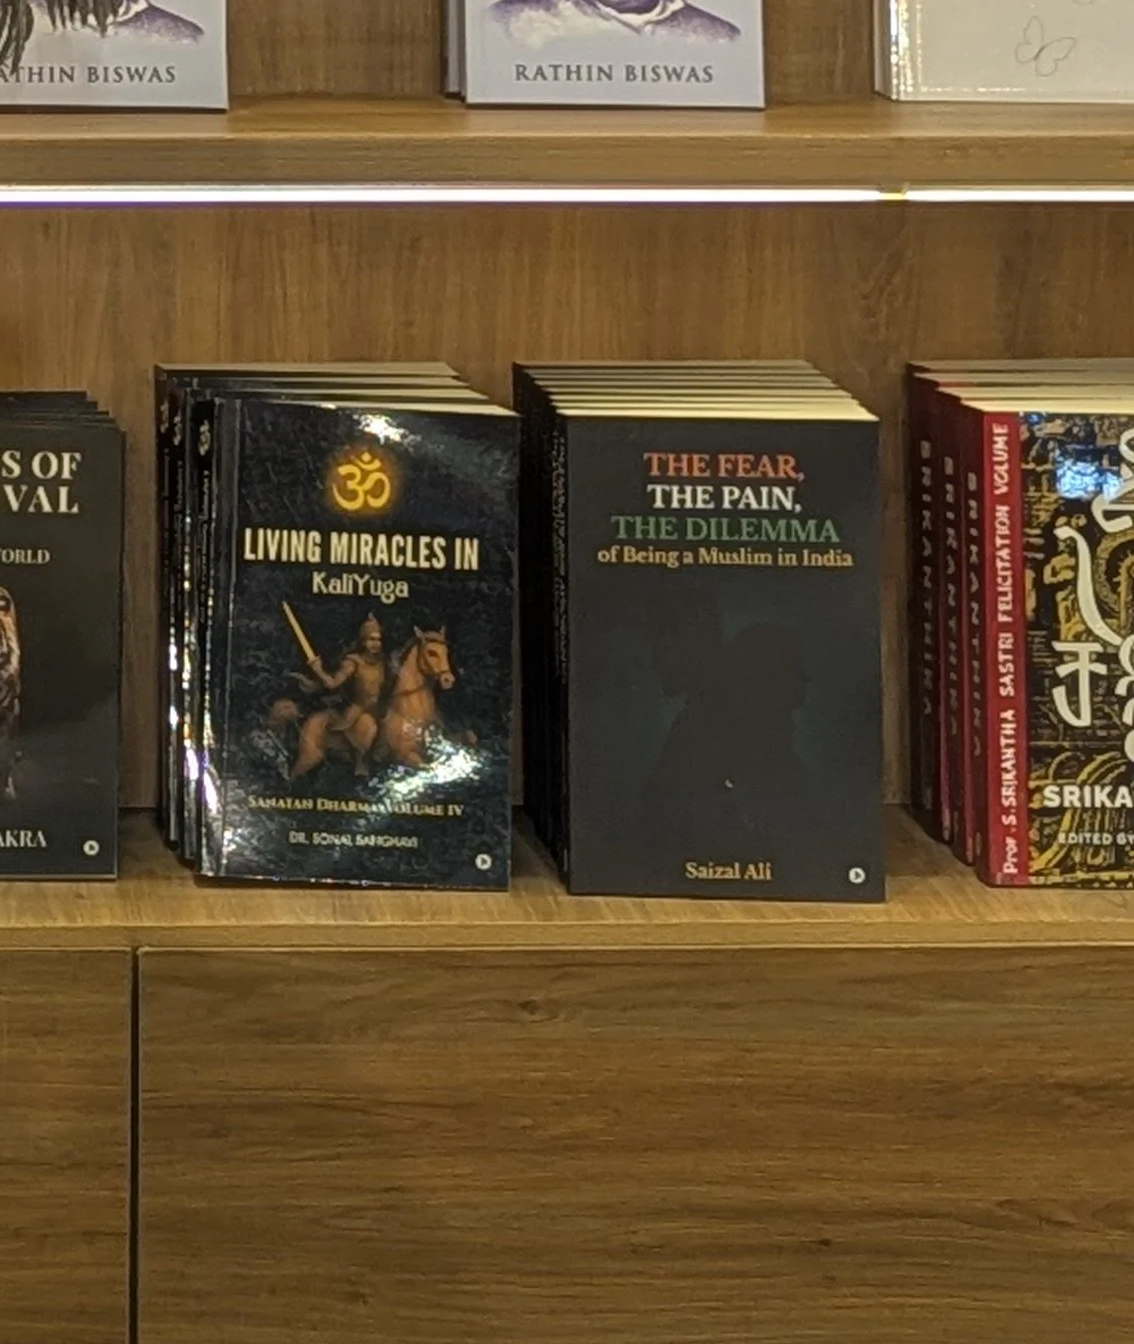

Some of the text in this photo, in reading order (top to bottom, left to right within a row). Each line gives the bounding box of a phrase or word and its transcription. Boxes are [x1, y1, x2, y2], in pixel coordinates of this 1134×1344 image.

[87, 66, 176, 83] BISWAS
[514, 64, 714, 84] RATHIN BISWAS
[31, 451, 81, 479] OF
[643, 453, 804, 480] THE FEAR,
[991, 422, 1009, 496] VOLUME
[646, 485, 802, 513] THE PAIN,
[611, 517, 840, 543] THE DILEMMA
[244, 529, 479, 570] LIVING MIRACLES IN
[597, 547, 853, 568] of Being a Muslim in India
[995, 503, 1013, 623] FELICITATION
[312, 572, 409, 603] KaliYuga
[997, 632, 1016, 697] SASTRI
[1043, 785, 1134, 808] SRIKA
[447, 805, 464, 816] IV
[1058, 833, 1112, 845] EDITED
[685, 862, 772, 881] Saizal Ali
